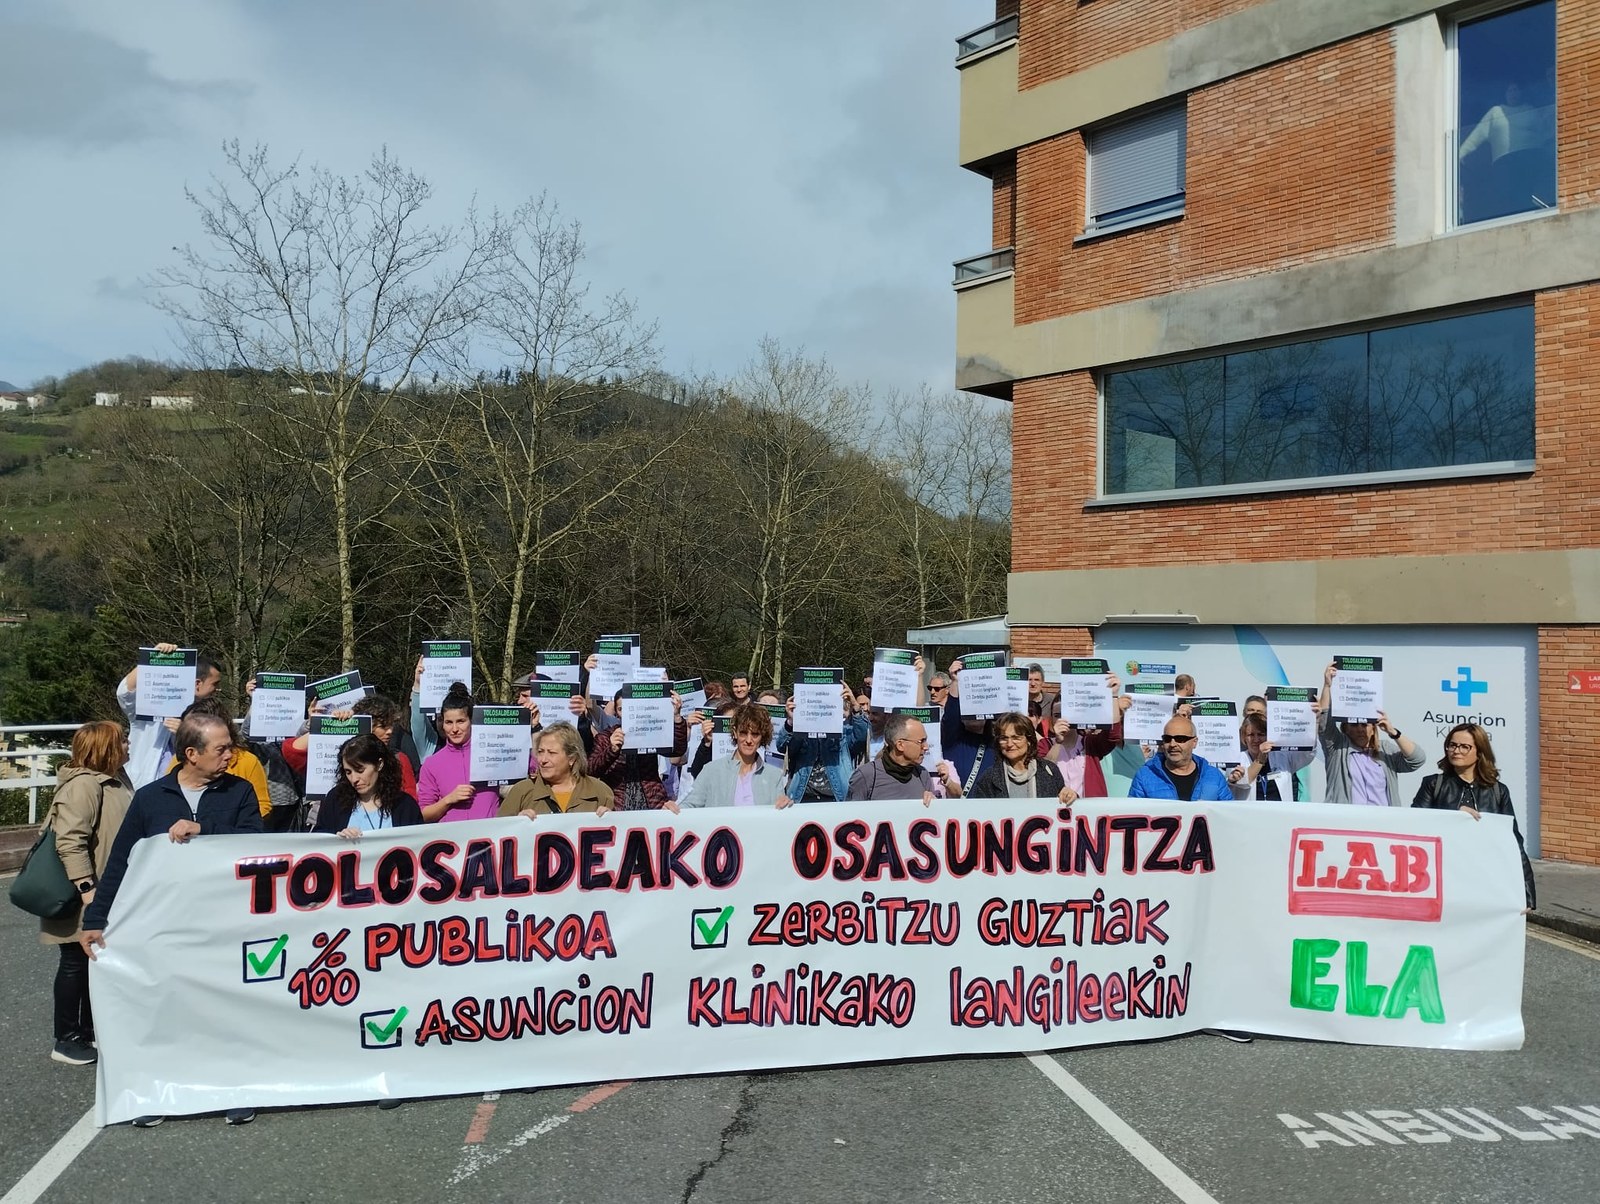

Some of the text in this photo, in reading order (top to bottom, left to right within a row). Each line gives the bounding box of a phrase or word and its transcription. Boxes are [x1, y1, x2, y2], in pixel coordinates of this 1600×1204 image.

[1423, 710, 1506, 727] Asuncion
[236, 825, 743, 914] TOLOSALDEAKO
[1296, 839, 1430, 893] LAB
[1290, 937, 1445, 1024] ELA
